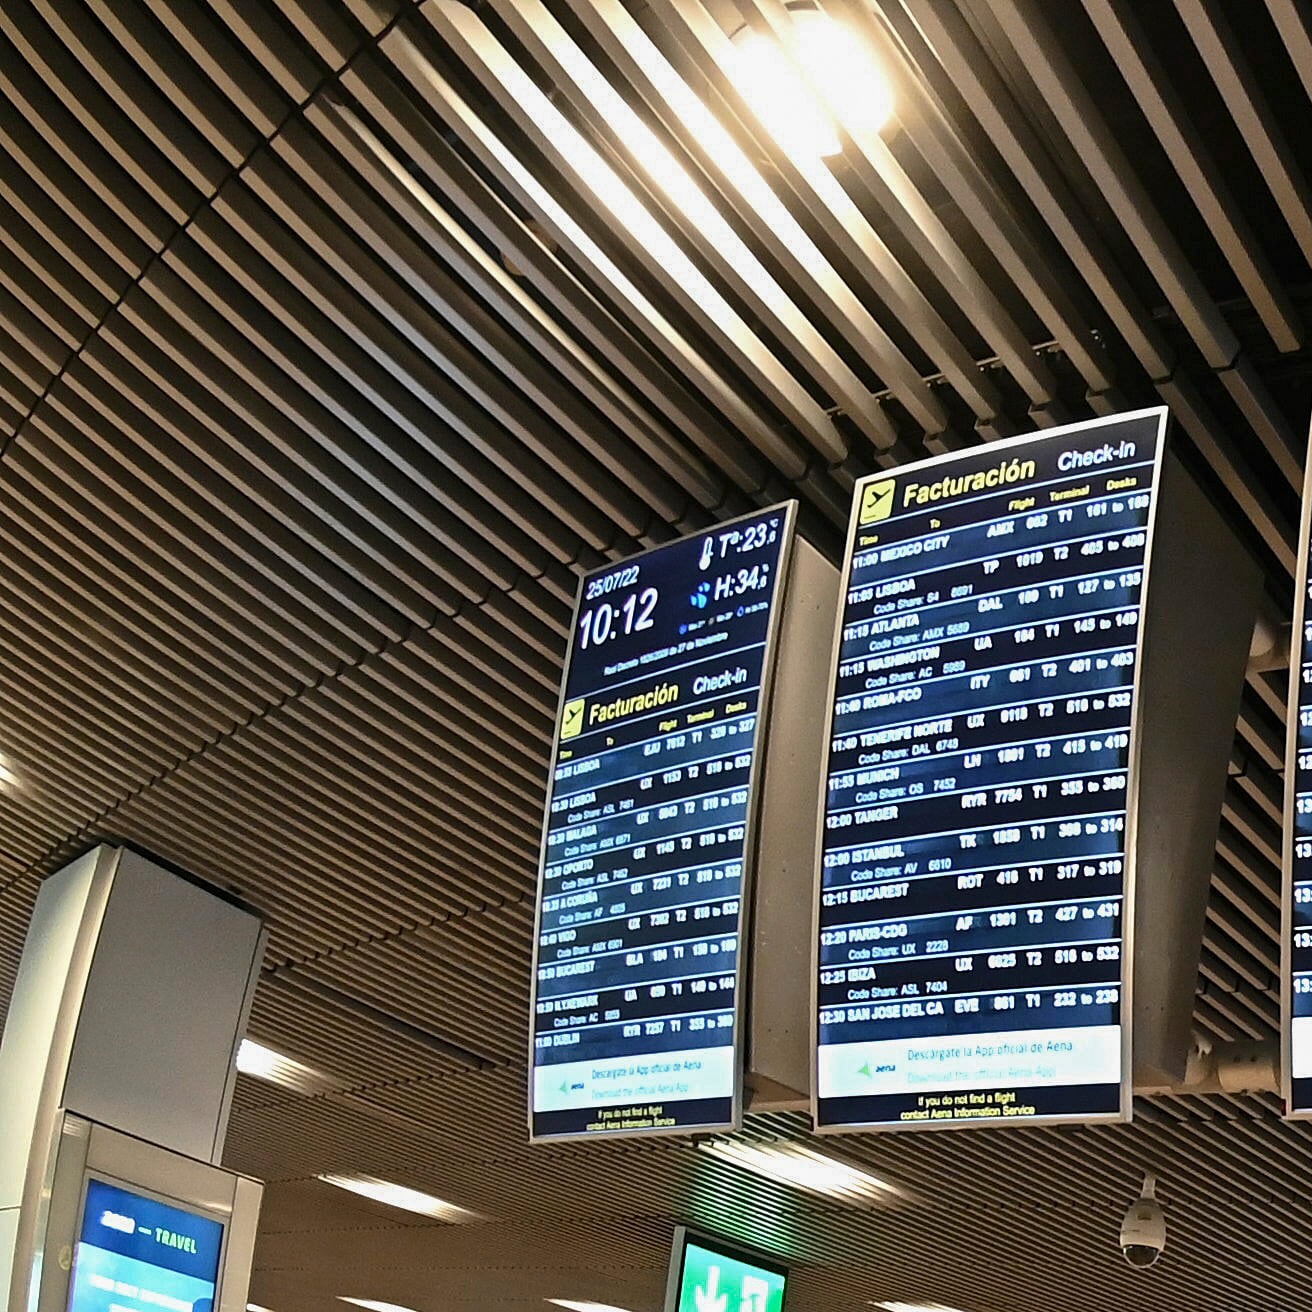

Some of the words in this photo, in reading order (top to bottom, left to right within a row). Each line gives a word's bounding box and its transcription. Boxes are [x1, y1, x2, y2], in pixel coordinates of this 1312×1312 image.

[903, 458, 1036, 508] Facturación
[1057, 440, 1136, 472] Check-in
[586, 564, 640, 600] 25/07/22
[579, 587, 659, 650] 10:12
[588, 682, 679, 726] Facturación
[692, 666, 747, 695] Check-in
[827, 814, 852, 828] 12:00
[854, 805, 898, 825] TANGER
[962, 793, 986, 808] RYR
[1032, 785, 1047, 798] T1
[1088, 782, 1099, 792] to
[156, 1228, 196, 1253] TRAVEL
